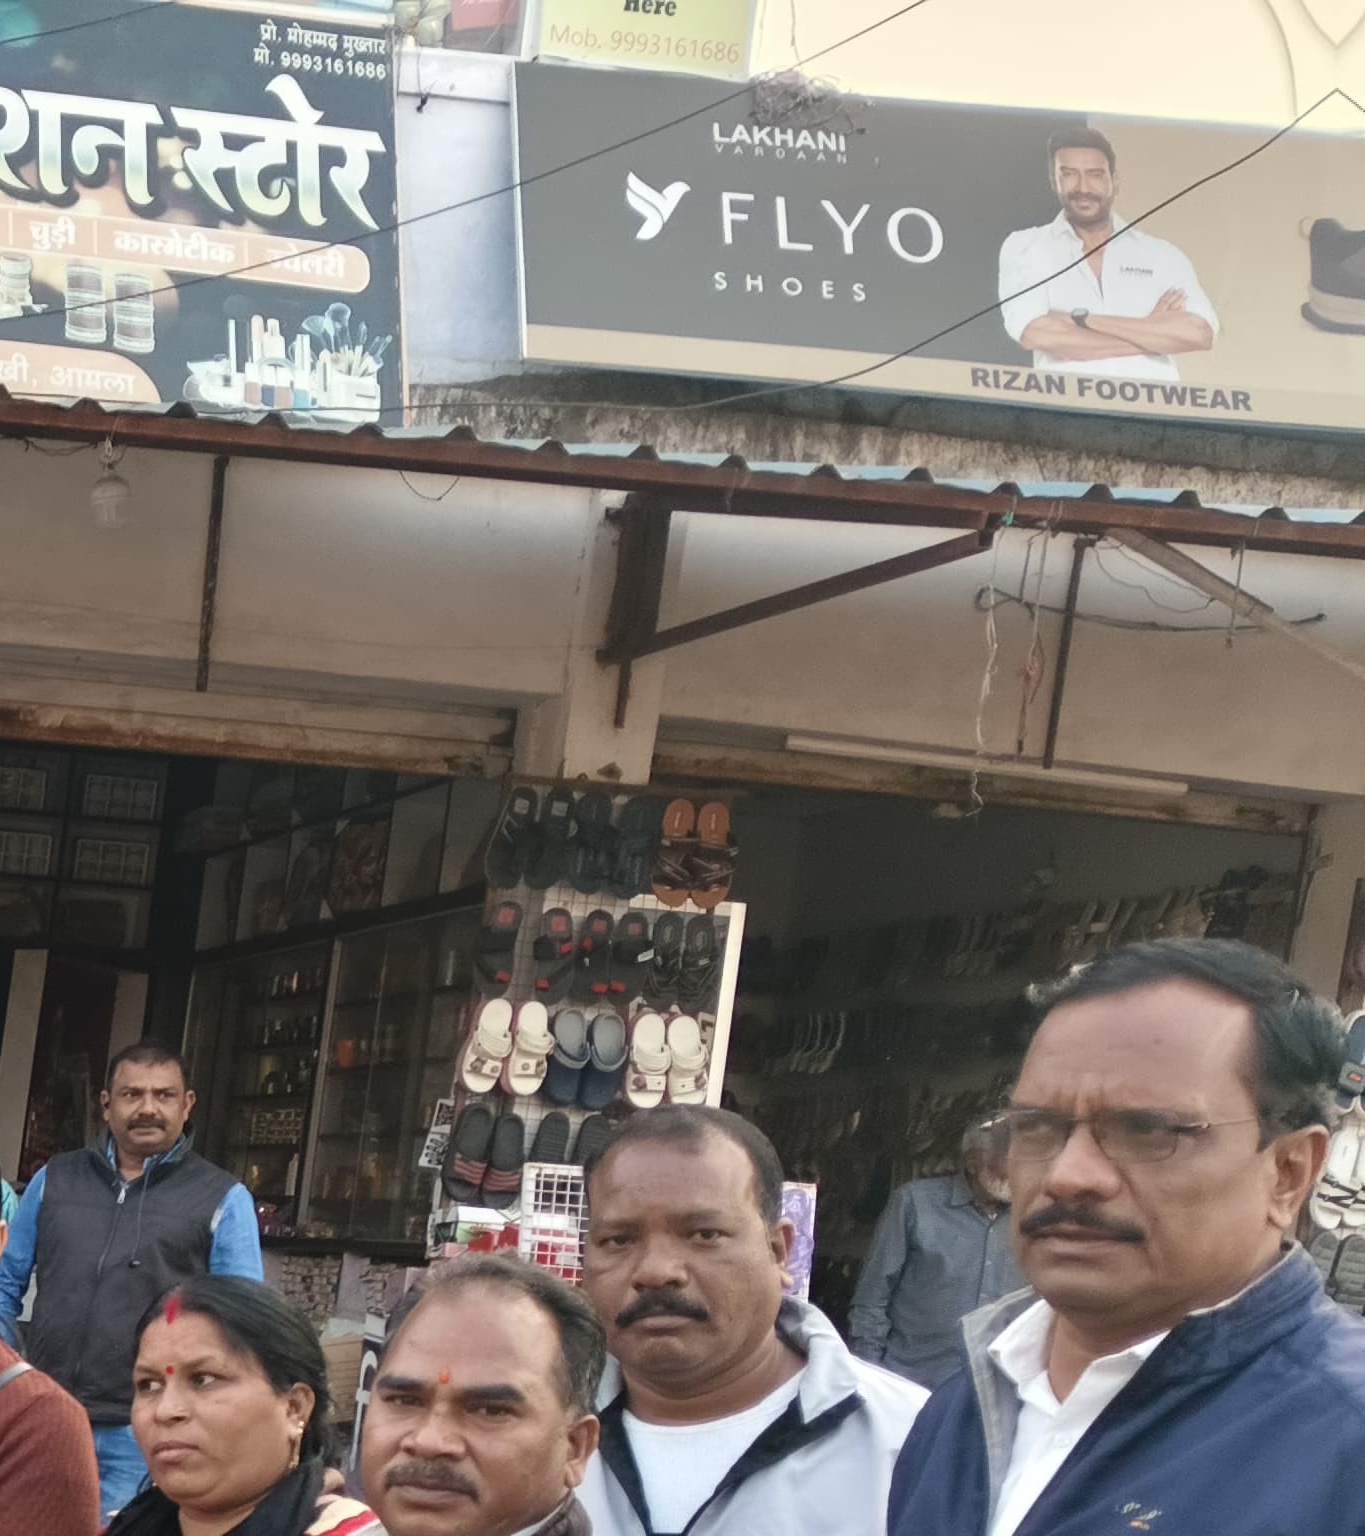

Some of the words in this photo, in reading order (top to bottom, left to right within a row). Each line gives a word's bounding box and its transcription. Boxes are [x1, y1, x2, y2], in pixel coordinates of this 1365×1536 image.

[259, 19, 282, 42] प्रो.
[287, 22, 338, 52] मोहम्मद
[549, 24, 602, 49] Mob.
[611, 30, 740, 63] 9993161686
[253, 43, 275, 66] मो.
[280, 51, 387, 80] 9993161686
[171, 75, 386, 229] स्टोर
[713, 122, 846, 152] LAKHANI
[715, 143, 847, 164] VARDAAN
[721, 192, 945, 264] FLYO
[713, 271, 867, 303] SHOES
[50, 364, 135, 396] आमला
[971, 366, 1067, 395] RIZAN
[1077, 377, 1253, 411] FOOTWEAR
